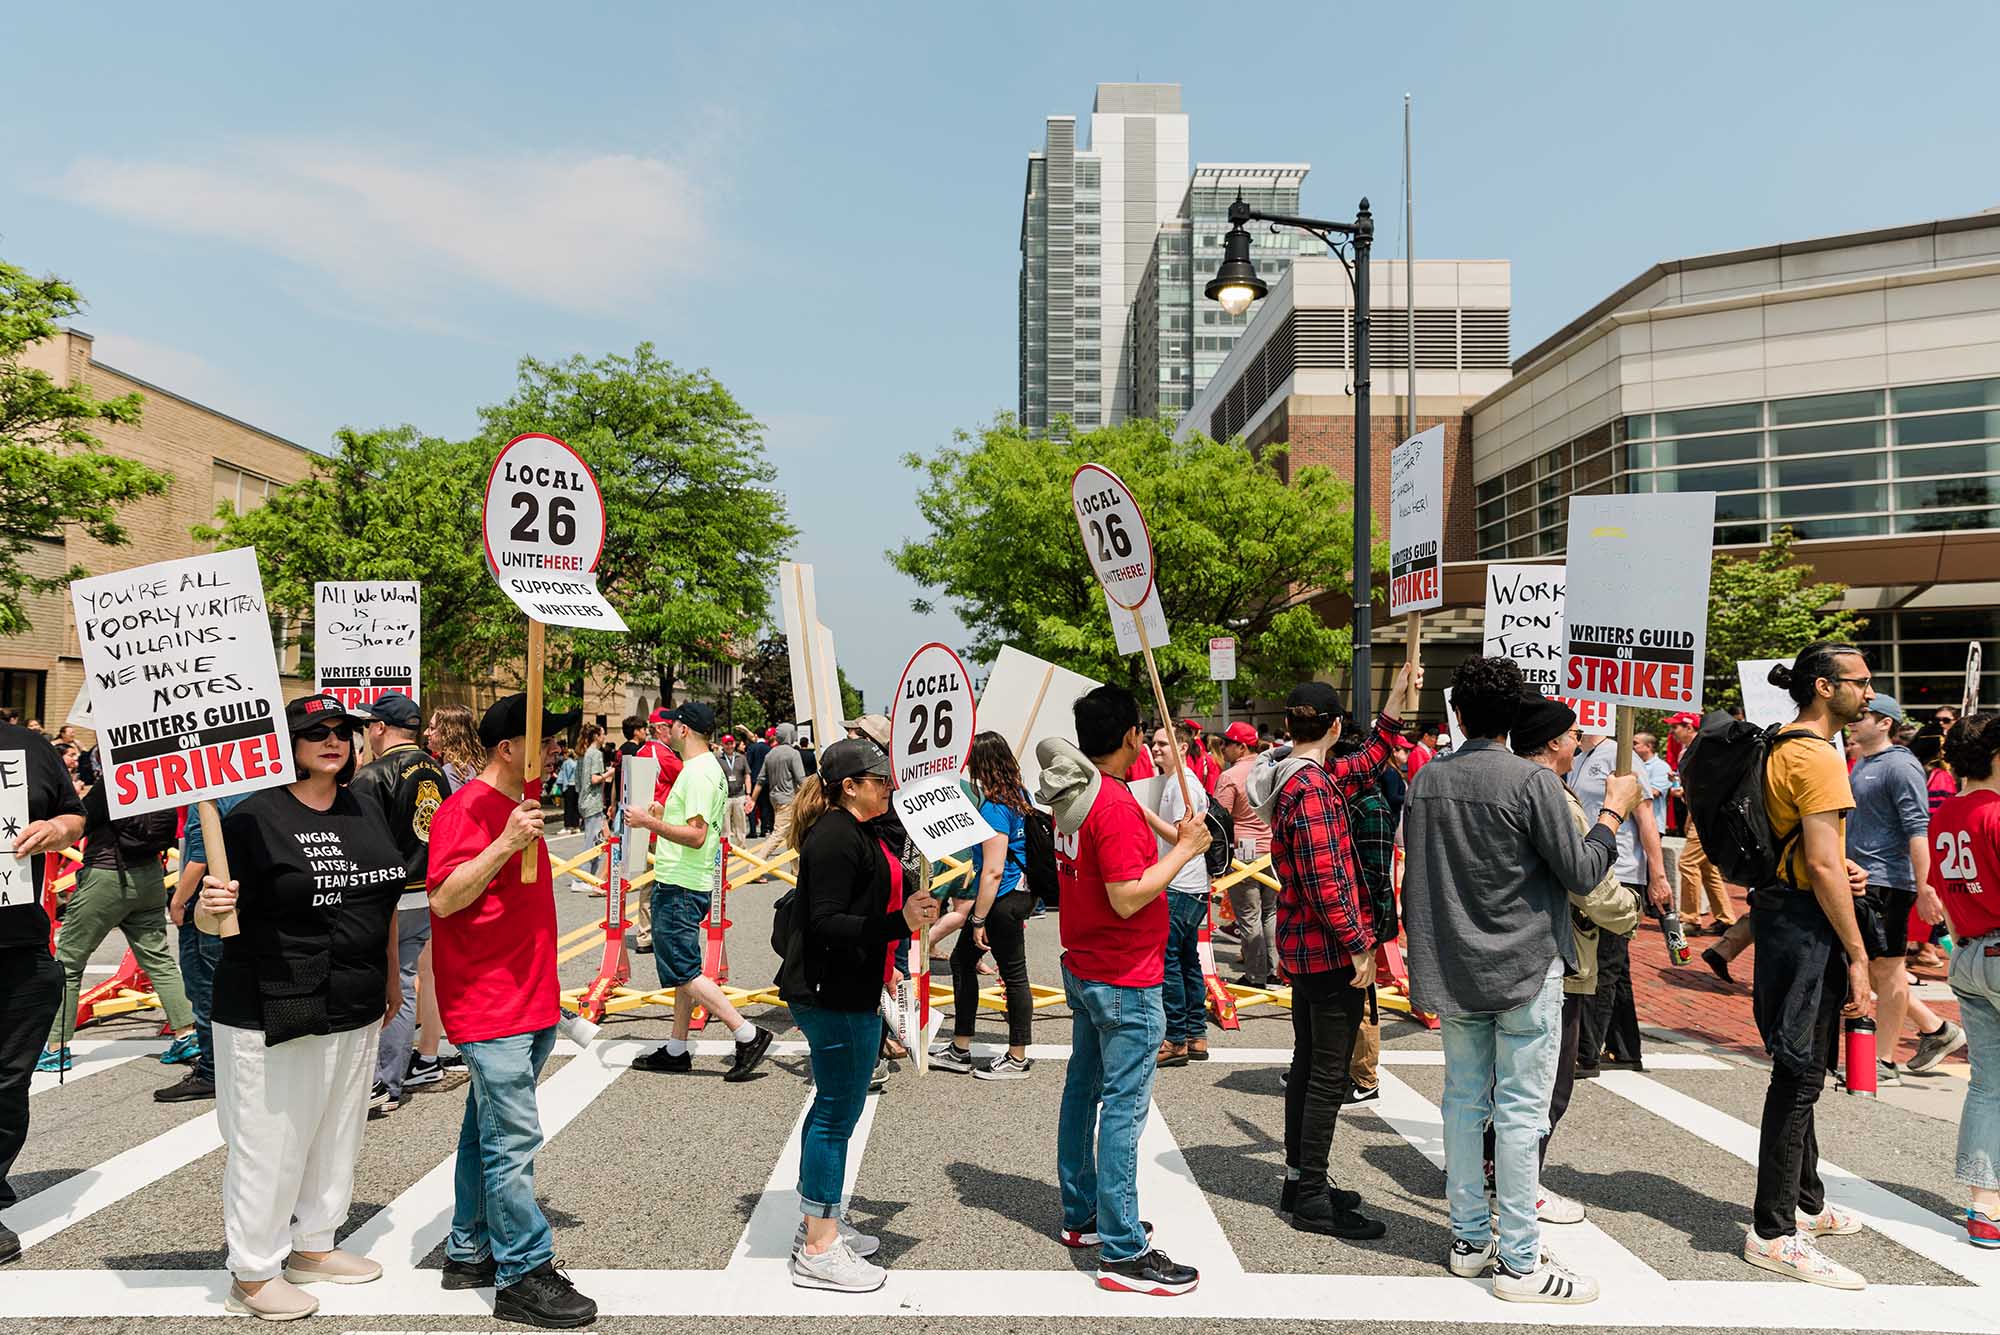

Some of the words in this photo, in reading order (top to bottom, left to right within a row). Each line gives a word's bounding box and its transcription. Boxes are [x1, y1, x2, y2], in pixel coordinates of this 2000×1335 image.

[505, 462, 584, 492] LOCAL
[1076, 488, 1121, 516] LOCAL
[510, 491, 576, 546] 26
[1089, 513, 1132, 562] 26
[502, 552, 583, 571] UNITEHERE!
[1392, 546, 1413, 566] WRITERS
[1414, 540, 1437, 559] GUILD
[1101, 562, 1147, 584] UNITEHERE!
[80, 579, 168, 615] YOU'RE
[179, 571, 230, 592] ALL
[354, 588, 378, 604] We
[511, 579, 592, 595] SUPPORTS
[1392, 567, 1439, 608] STRIKE!
[1492, 573, 1566, 605] WORK
[533, 602, 604, 617] WRITERS
[1501, 611, 1564, 630] DON'
[85, 605, 180, 641] POORLY
[328, 621, 363, 635] Our
[372, 618, 410, 632] Fair
[342, 630, 415, 650] Share!
[1487, 633, 1562, 660] JERK
[1570, 624, 1634, 645] WRITERS
[1639, 629, 1695, 649] GUILD
[1617, 647, 1633, 659] ON
[96, 664, 137, 690] WE
[142, 655, 216, 682] HAVE
[321, 667, 371, 677] WRITERS
[374, 666, 411, 677] GUILD
[360, 679, 371, 687] ON
[1522, 669, 1557, 683] TERS
[1567, 655, 1694, 702] STRIKE!
[153, 673, 253, 713] NOTES.
[906, 673, 959, 699] LOCAL
[1540, 685, 1556, 695] ON
[107, 711, 198, 747] WRITERS
[203, 699, 271, 727] GUILD
[908, 699, 953, 755] 26
[178, 732, 200, 750] ON
[115, 733, 283, 805] STRIKE!
[901, 755, 958, 783] UNITEHERE!
[903, 785, 961, 815] SUPPORTS
[294, 832, 341, 844] WGA&
[923, 812, 975, 840] WRITERS
[303, 845, 344, 858] SAG&
[1936, 830, 1978, 880] 26
[314, 866, 407, 889] TEAMSTERS&
[312, 892, 343, 907] DGA
